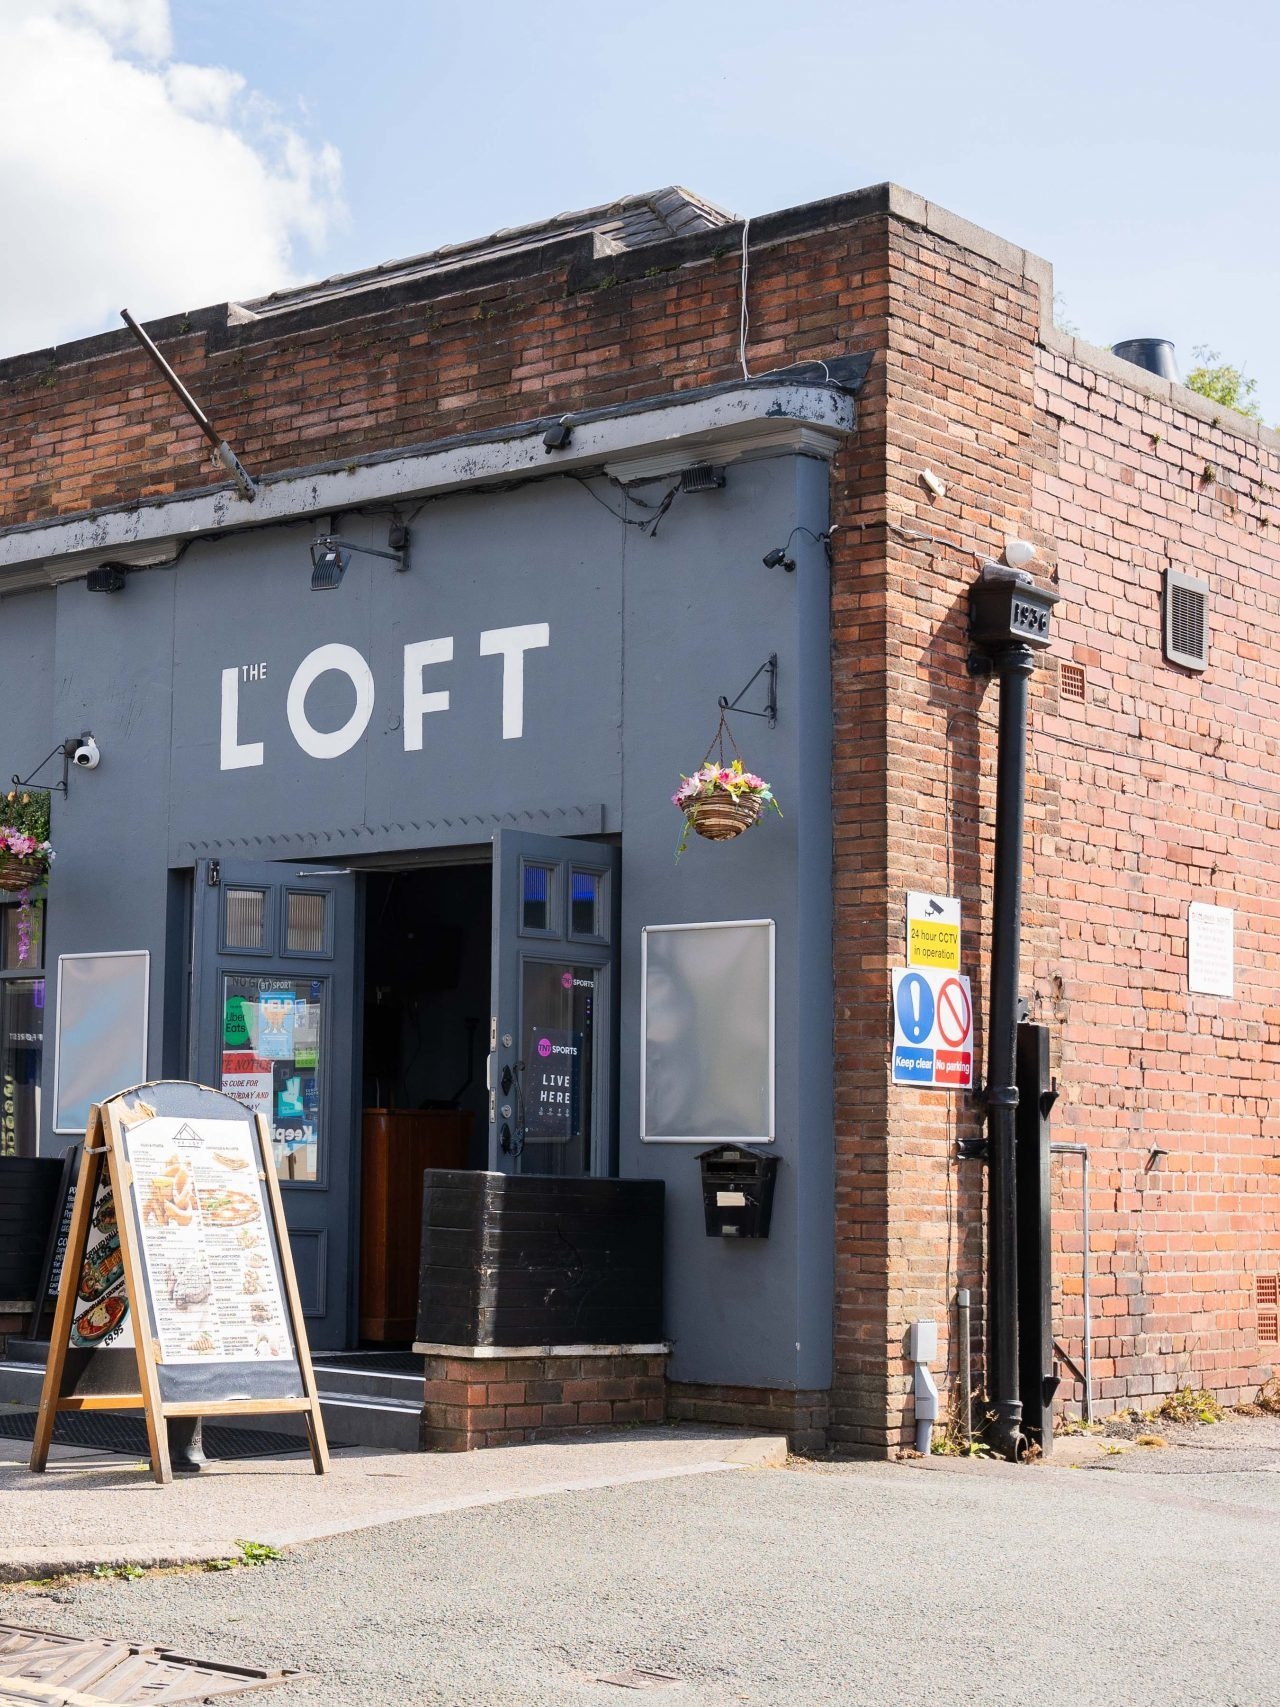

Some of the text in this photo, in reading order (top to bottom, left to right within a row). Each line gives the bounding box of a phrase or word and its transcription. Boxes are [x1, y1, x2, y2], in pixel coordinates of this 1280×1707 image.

[1014, 602, 1047, 632] 1936
[242, 662, 267, 682] THE
[220, 622, 549, 770] LOFT
[911, 928, 958, 944] 24 hour CCTV
[914, 944, 955, 960] in operation
[272, 981, 292, 989] SPORT
[573, 978, 595, 988] SPORTS
[226, 1012, 246, 1022] Uber
[226, 1023, 246, 1033] Eats
[552, 1045, 578, 1055] SPORTS
[236, 1059, 271, 1072] NOTICE
[895, 1056, 933, 1070] Keep clear
[935, 1059, 970, 1075] No parking
[246, 1079, 259, 1087] FOR
[542, 1074, 570, 1087] LIVE
[256, 1091, 270, 1099] AND
[540, 1090, 570, 1104] HERE
[104, 1324, 124, 1347] £9.95
